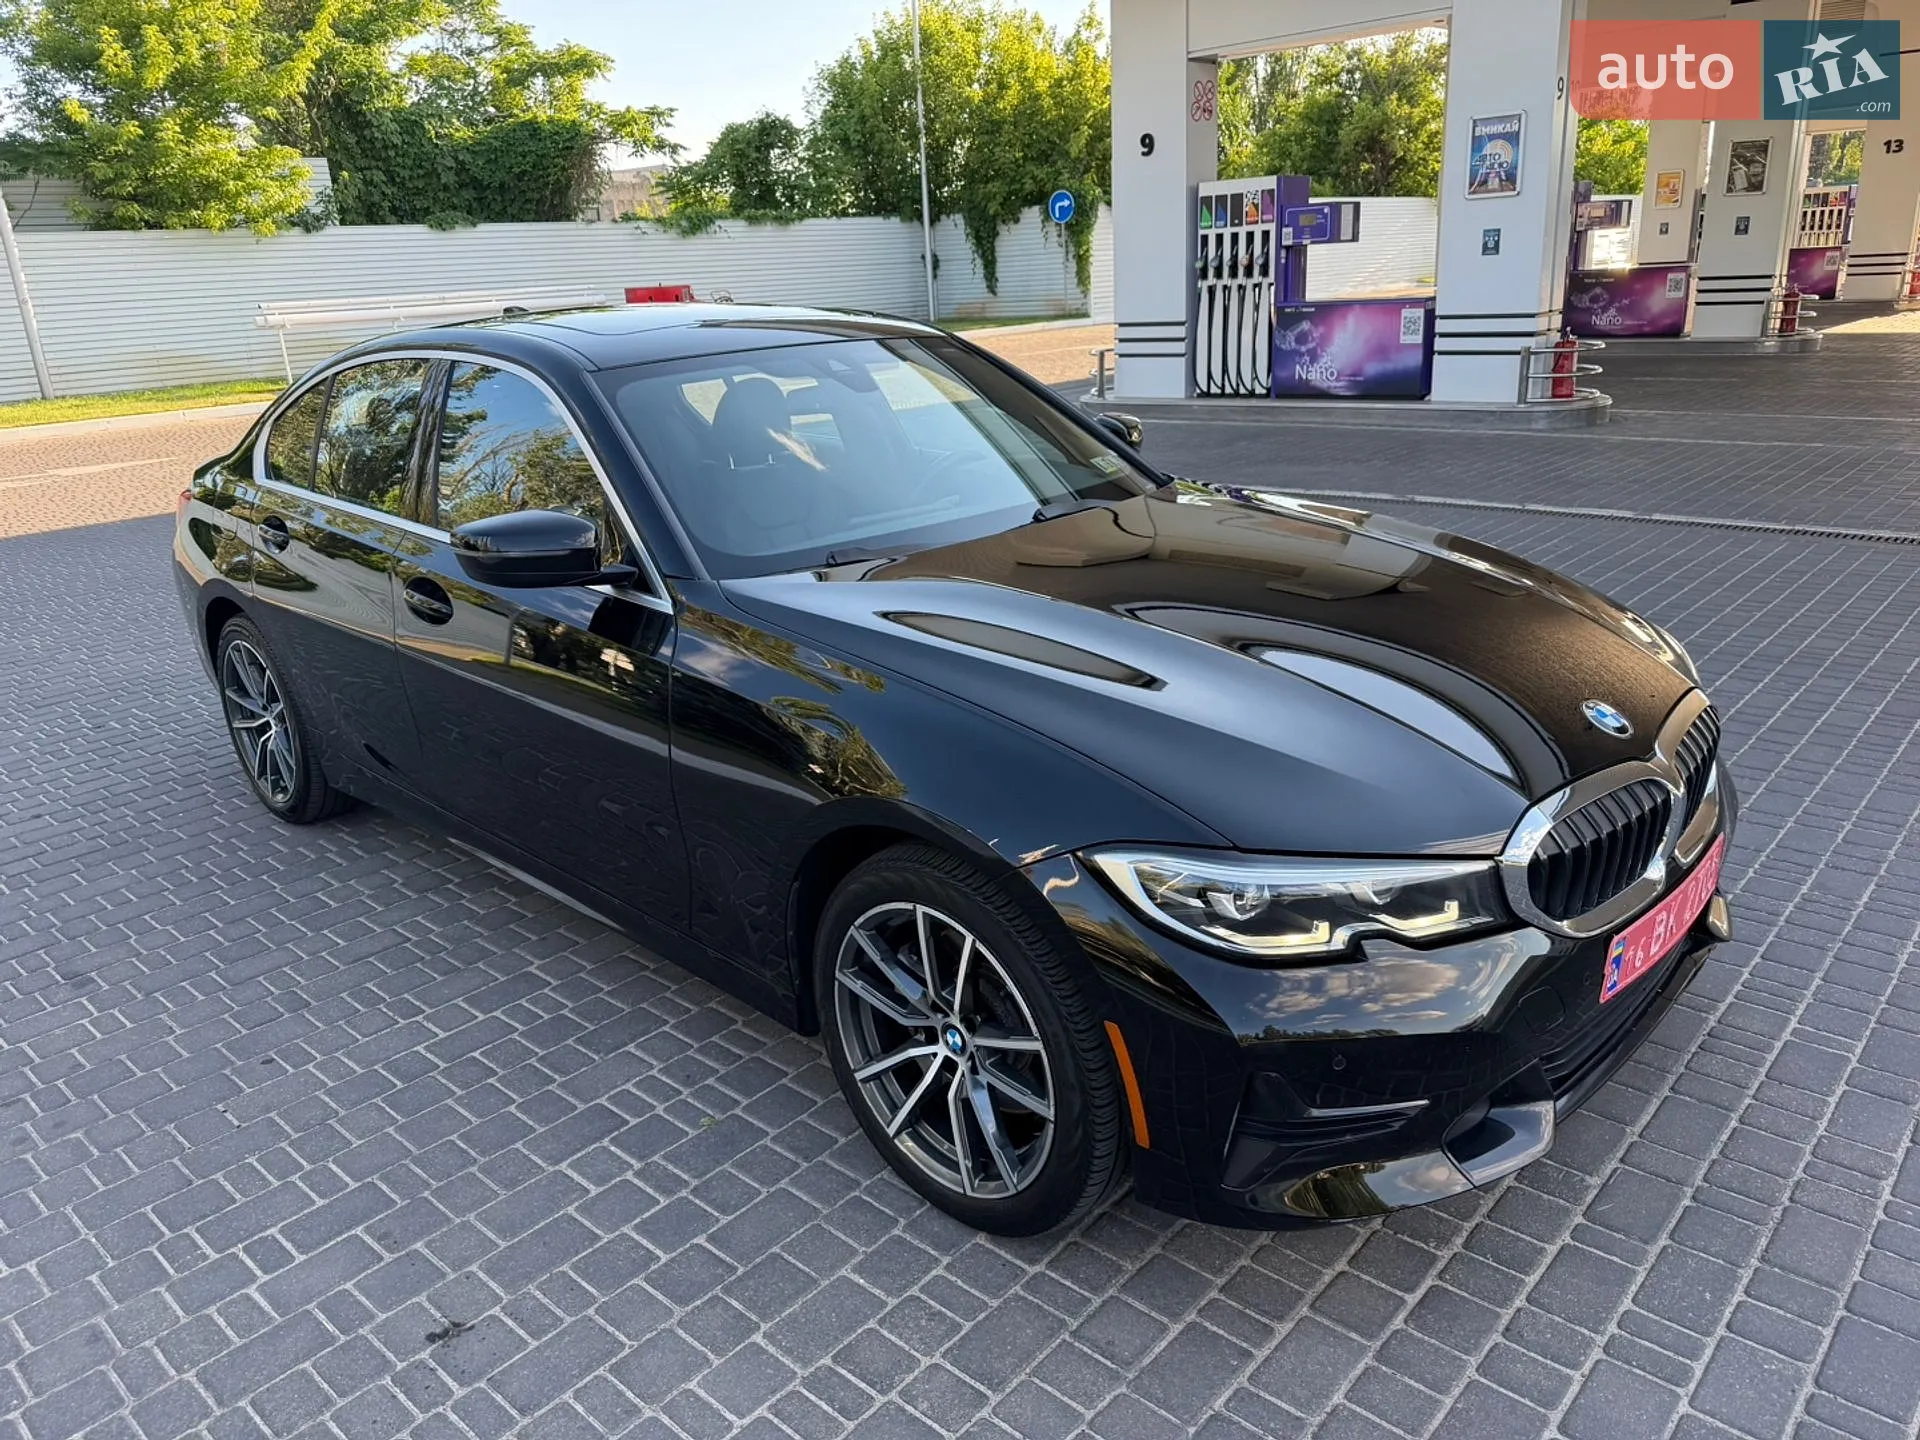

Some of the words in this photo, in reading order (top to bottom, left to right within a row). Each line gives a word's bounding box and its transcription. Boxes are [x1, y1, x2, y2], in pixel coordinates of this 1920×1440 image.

[1557, 76, 1565, 100] 9
[1140, 132, 1155, 157] 9
[1883, 139, 1905, 154] 13
[1591, 314, 1622, 326] Nano
[1295, 363, 1338, 381] Nano
